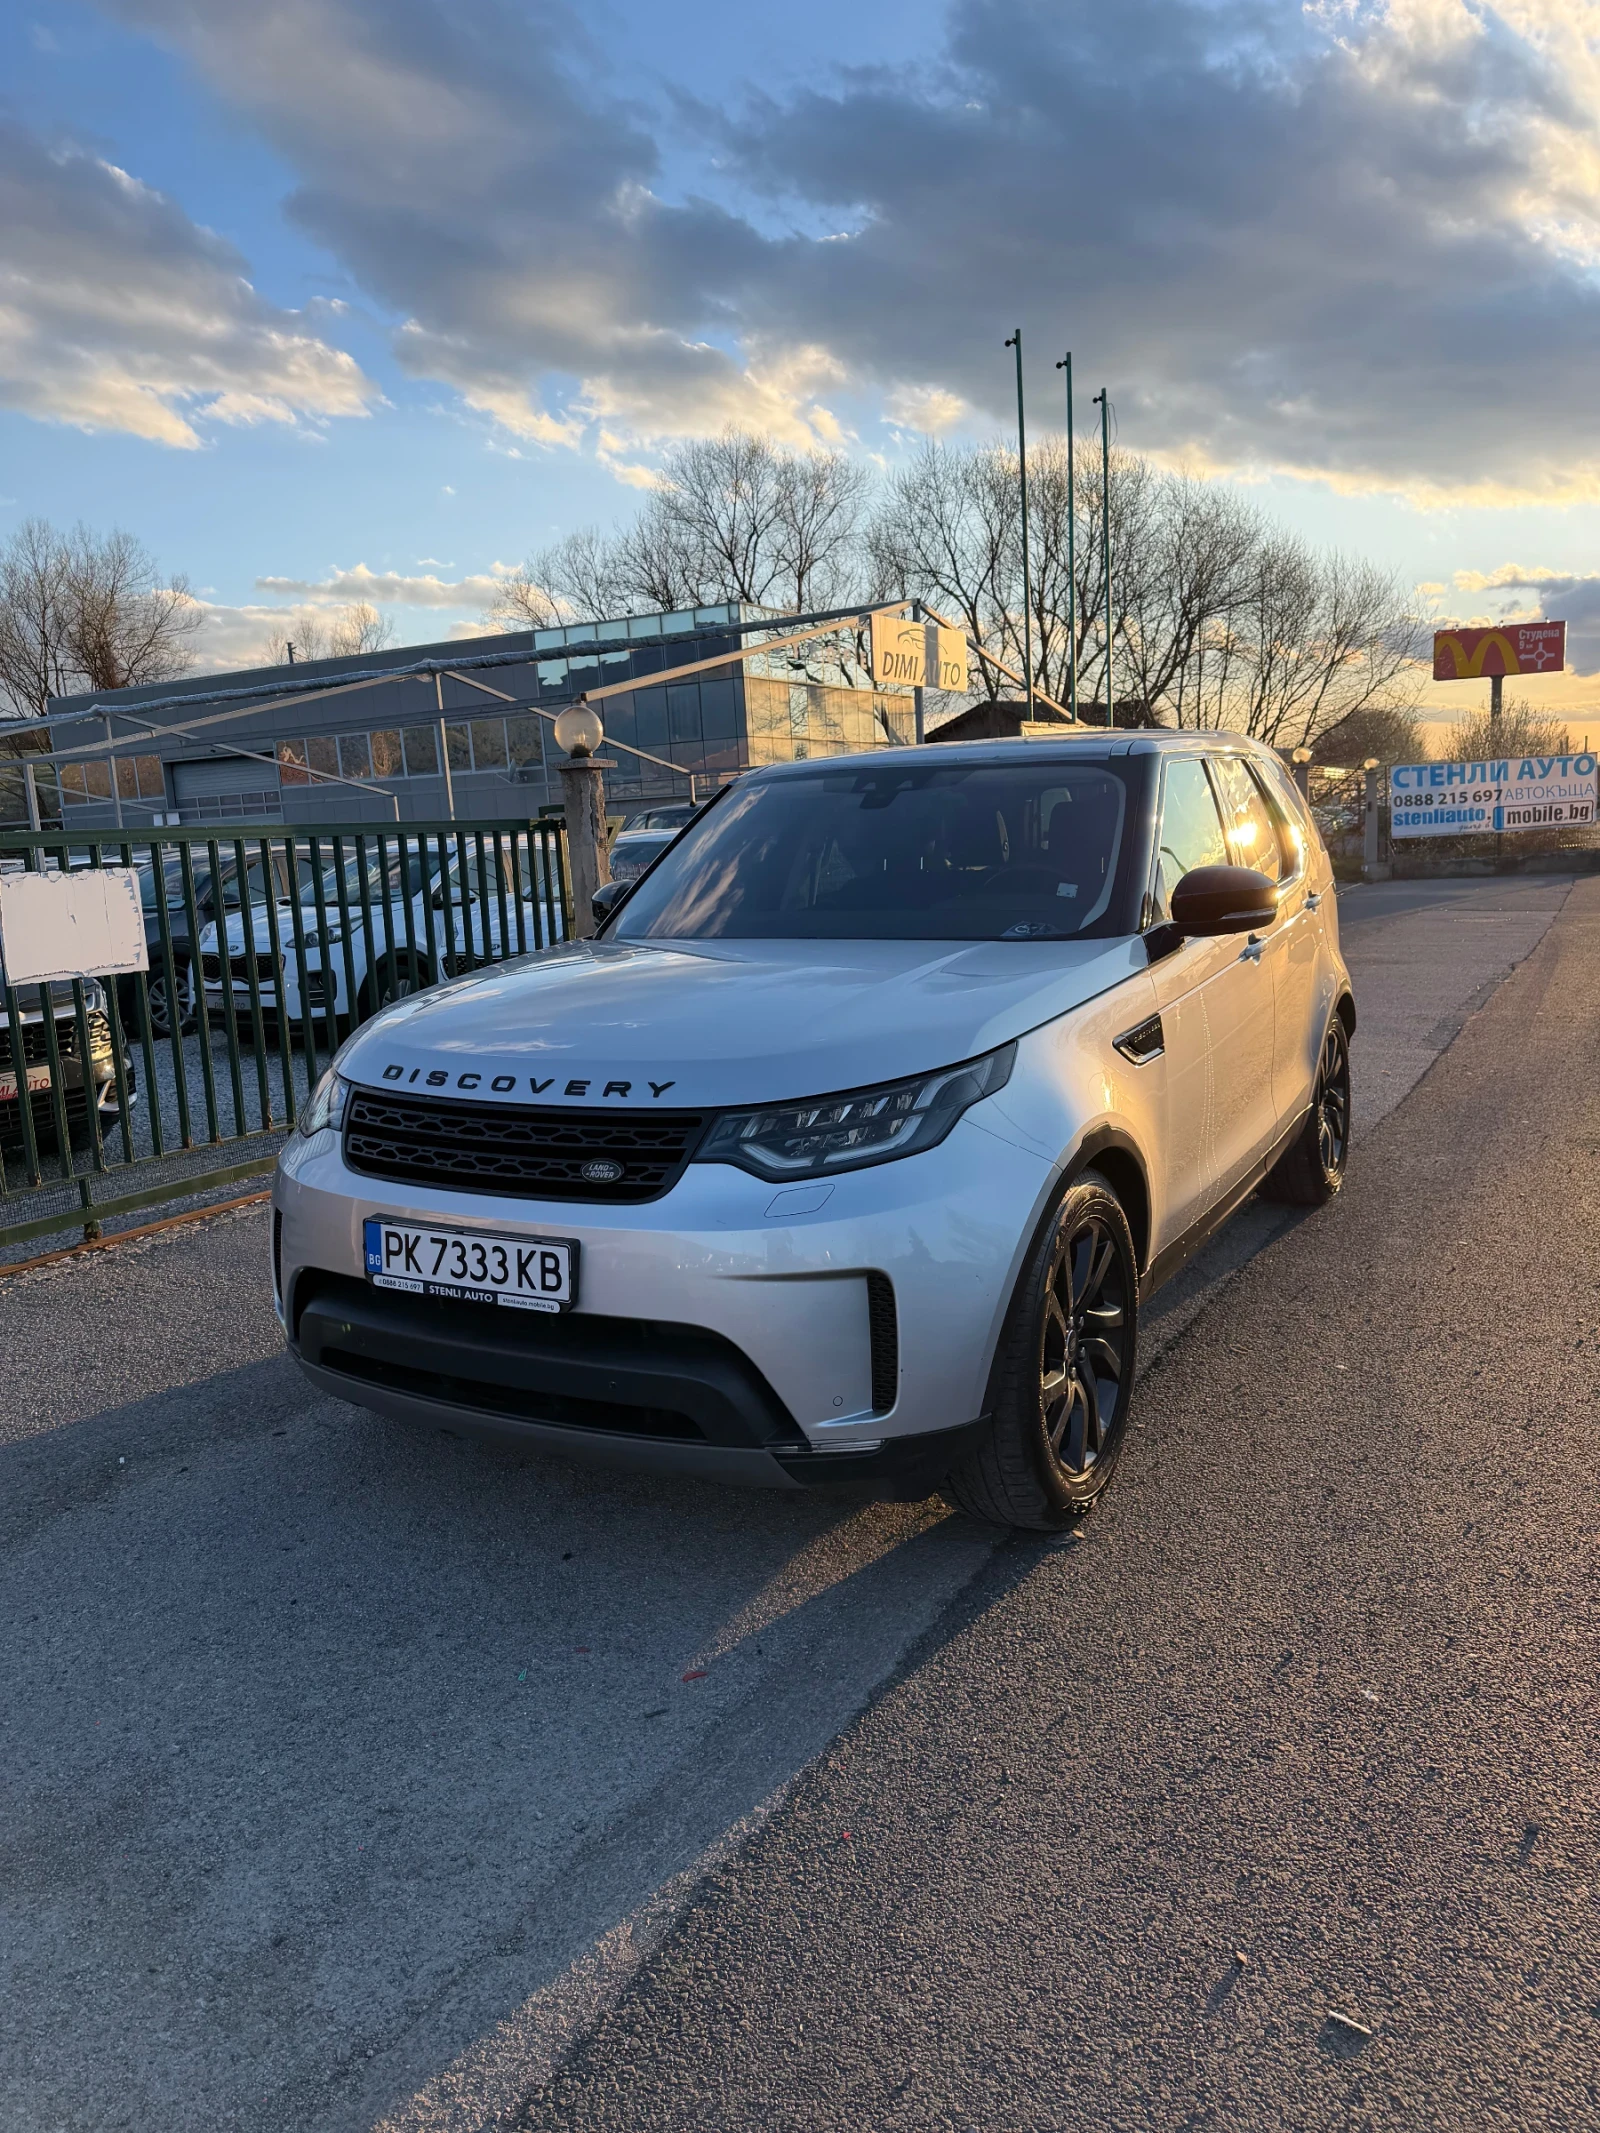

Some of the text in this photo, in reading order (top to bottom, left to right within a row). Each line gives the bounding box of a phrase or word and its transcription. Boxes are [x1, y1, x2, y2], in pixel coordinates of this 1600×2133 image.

[1519, 629, 1559, 642] Студена
[1519, 641, 1525, 649] 9
[882, 651, 919, 681] DIMI
[920, 658, 961, 686] AUTO
[1393, 755, 1596, 789] СТЕНЛИ АУТО
[1393, 789, 1503, 808] 0888 215 697
[1505, 783, 1595, 801] АВТОКЪЩА
[1507, 804, 1590, 825] mobile.bg
[382, 1064, 676, 1098] DISCOVERY
[369, 1253, 382, 1266] BG
[384, 1230, 563, 1292] PK 7333 KB
[397, 1281, 409, 1289] 215
[410, 1283, 421, 1291] 697
[429, 1285, 493, 1303] STENLI AUTO
